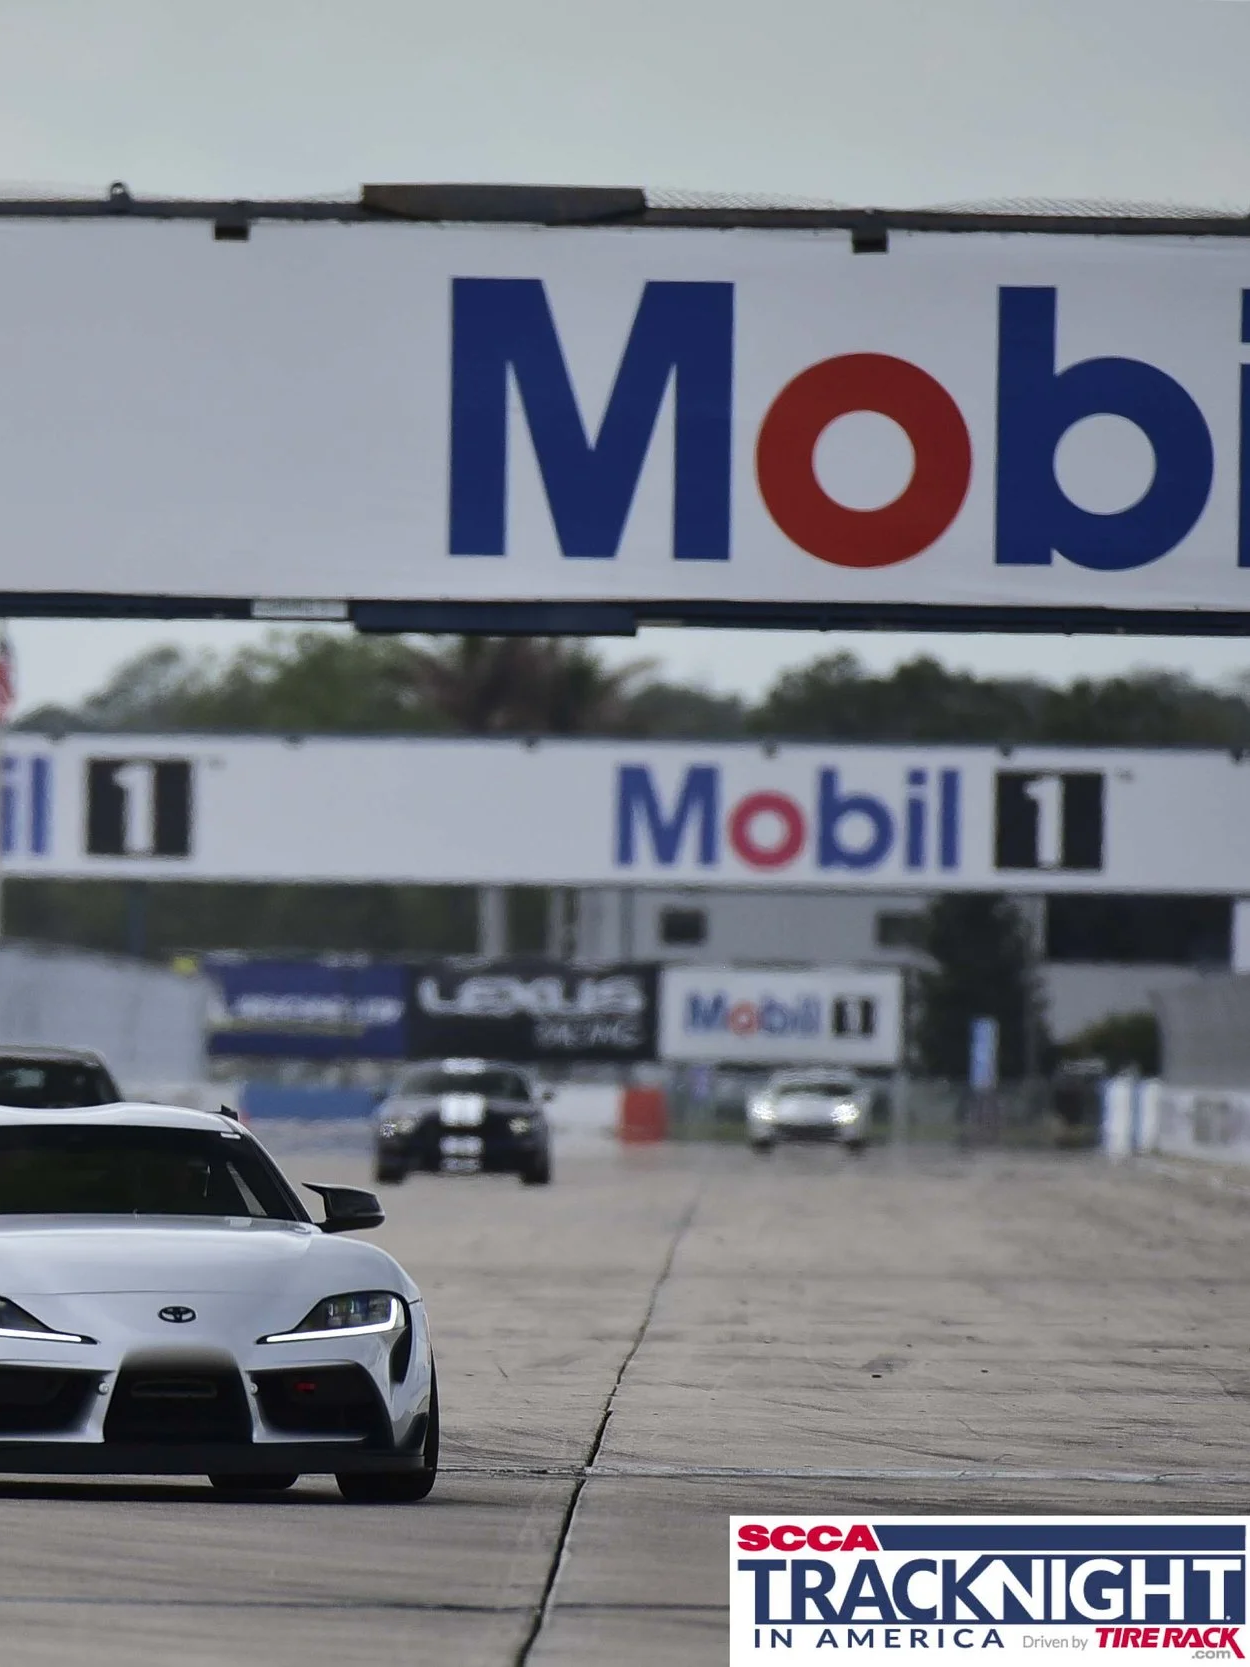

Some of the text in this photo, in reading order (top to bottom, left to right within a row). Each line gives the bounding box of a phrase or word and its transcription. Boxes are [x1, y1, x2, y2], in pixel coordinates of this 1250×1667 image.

[449, 276, 1250, 572] Mob
[615, 763, 960, 869] Mobil
[418, 975, 645, 1018] LEXUS
[684, 990, 822, 1037] Mobil
